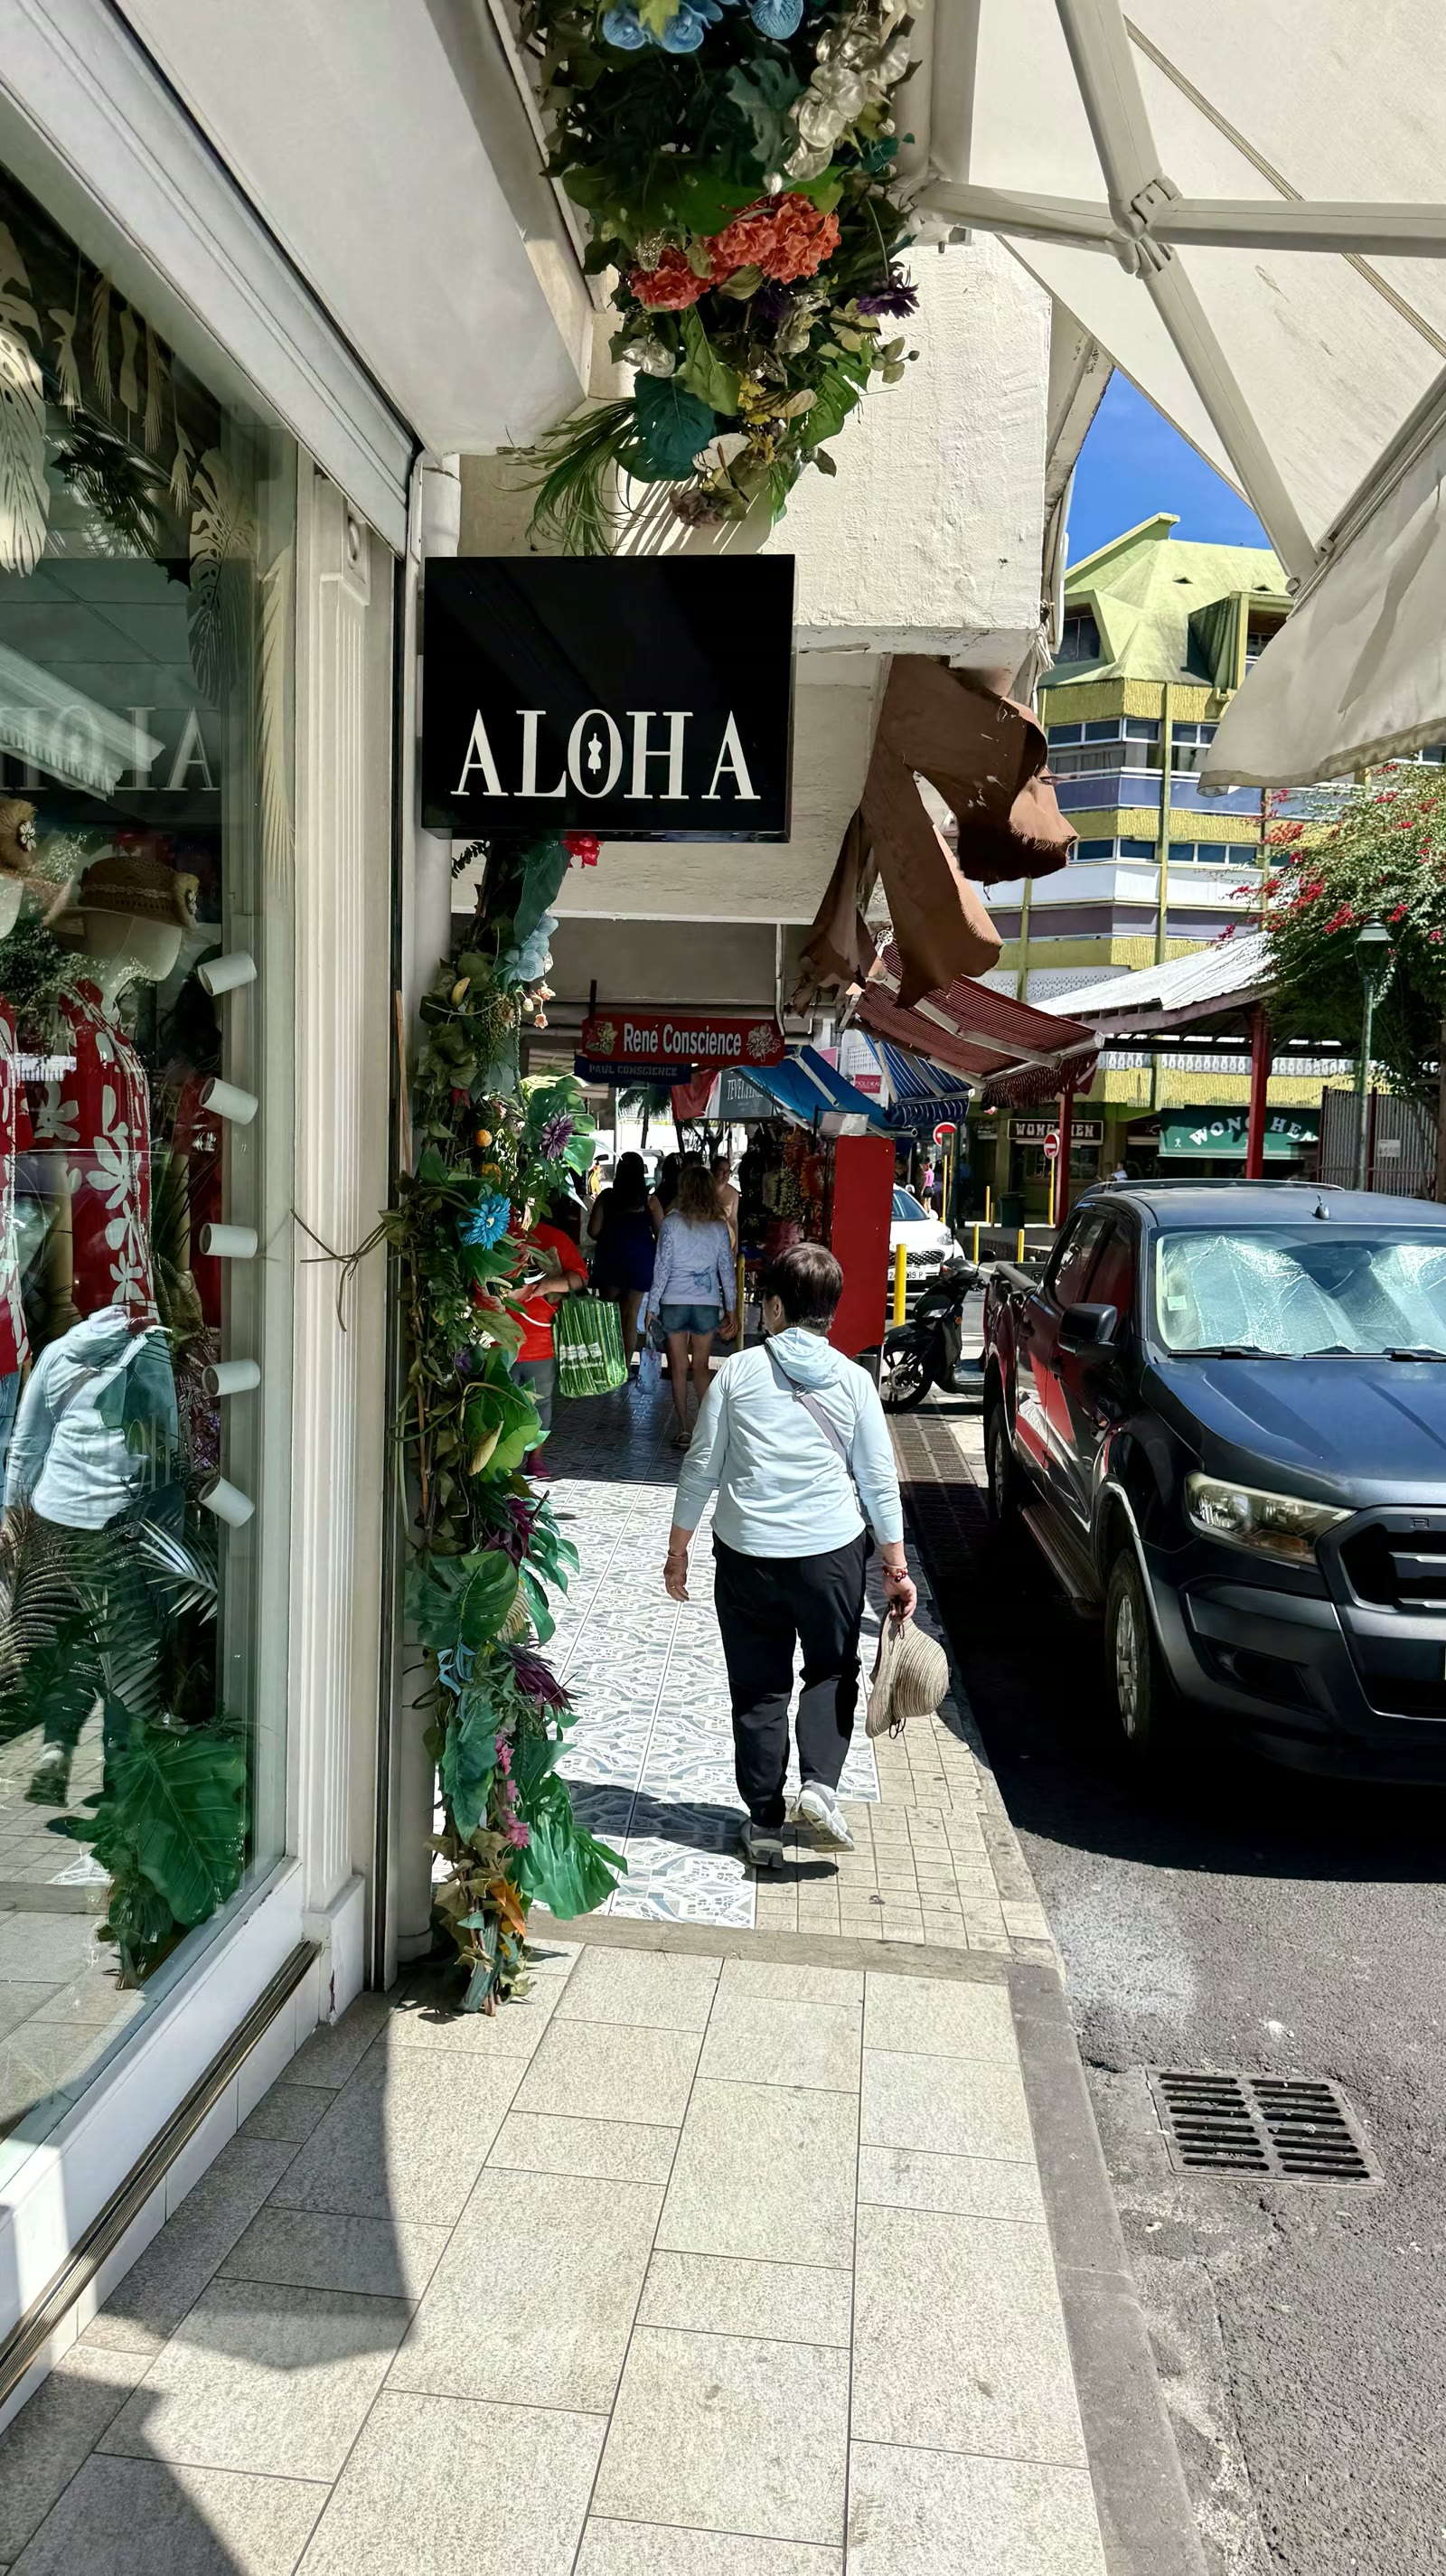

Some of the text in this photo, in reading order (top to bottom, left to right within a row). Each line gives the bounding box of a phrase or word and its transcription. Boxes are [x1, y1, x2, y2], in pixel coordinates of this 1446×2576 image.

[450, 709, 761, 800] ALOHA
[624, 1023, 742, 1056] René Conscience
[588, 1063, 678, 1076] PAUL CONSCIENCE
